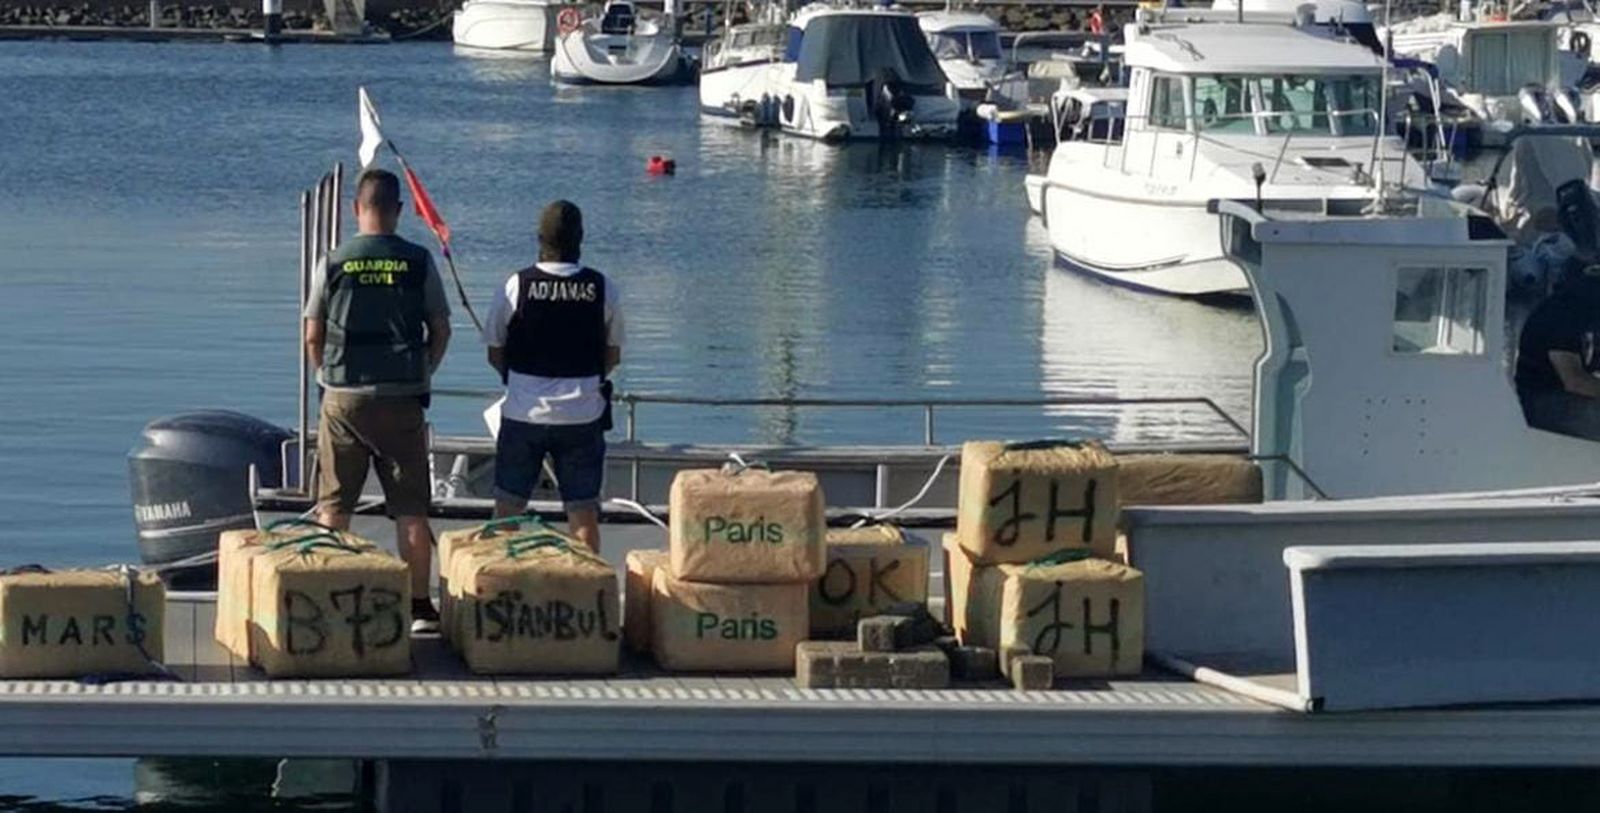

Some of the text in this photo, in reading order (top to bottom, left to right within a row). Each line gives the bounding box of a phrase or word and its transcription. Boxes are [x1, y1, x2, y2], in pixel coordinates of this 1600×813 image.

[343, 260, 408, 273] GUARDIA
[360, 273, 393, 284] CIVIL
[140, 501, 192, 521] YAMAHA
[705, 516, 784, 544] Paris
[819, 558, 901, 605] OK
[22, 614, 146, 645] MARS
[697, 611, 777, 640] Paris
